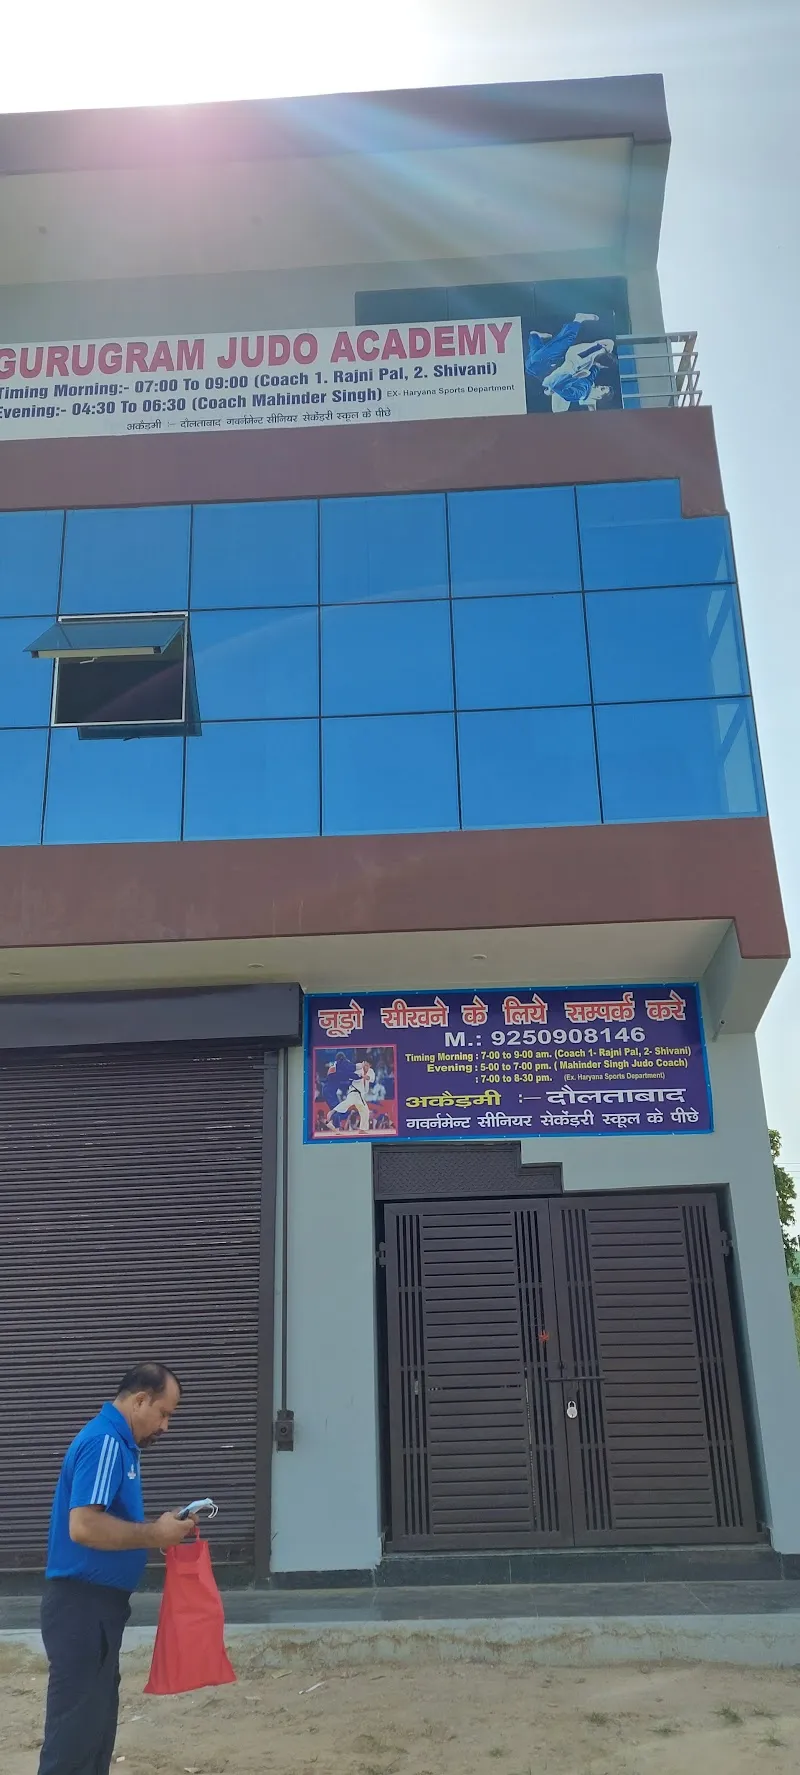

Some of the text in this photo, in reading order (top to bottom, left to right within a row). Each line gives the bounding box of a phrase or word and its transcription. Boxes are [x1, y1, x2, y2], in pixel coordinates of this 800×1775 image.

[0, 322, 512, 379] GURUGRAM JUDO ACADEMY
[0, 361, 497, 399] Timing Morning:- 07:00 To 09:00 (Coach 1. Rajni Pal, 2. Shivani)
[0, 406, 67, 419] Evening:-
[72, 401, 115, 415] 04:30
[121, 400, 139, 413] To
[143, 398, 186, 412] 06:30
[192, 393, 246, 411] (Coach
[252, 389, 326, 406] Mahinder
[332, 388, 382, 403] Singh)
[403, 388, 436, 397] Haryana
[439, 387, 465, 395] Sports
[468, 384, 514, 393] Department
[267, 413, 297, 423] सीनियर
[337, 412, 358, 421] स्कूल
[362, 408, 371, 418] के
[376, 407, 391, 417] पीछे
[381, 996, 449, 1028] सीखने
[462, 995, 489, 1025] के
[502, 993, 548, 1025] लिये
[564, 991, 635, 1024] सम्पर्क
[645, 990, 686, 1021] करे
[445, 1027, 645, 1046] M.: 9250908146
[405, 1054, 435, 1062] Timing
[438, 1053, 473, 1062] Morning
[481, 1051, 500, 1060] 7-00
[514, 1050, 533, 1058] 9-00
[555, 1049, 585, 1059] (Coach
[599, 1048, 622, 1057] Rajni
[625, 1048, 641, 1056] Pal,
[655, 1046, 691, 1056] Shivani)
[427, 1064, 472, 1073] Evening
[480, 1063, 500, 1071] 5-00
[513, 1062, 533, 1070] 7-00
[535, 1062, 552, 1071] pm.
[604, 1059, 628, 1069] Singh
[632, 1059, 653, 1068] Judo
[656, 1058, 688, 1068] Coach)
[481, 1075, 501, 1083] 7-00
[514, 1074, 533, 1082] 8-30
[536, 1074, 552, 1083] pm.
[546, 1085, 686, 1105] दौलताबाद
[406, 1113, 471, 1129] गवर्नमेन्ट
[477, 1112, 532, 1128] सीनियर
[602, 1113, 640, 1128] स्कूल
[647, 1108, 663, 1123] के
[671, 1107, 699, 1123] पीछे
